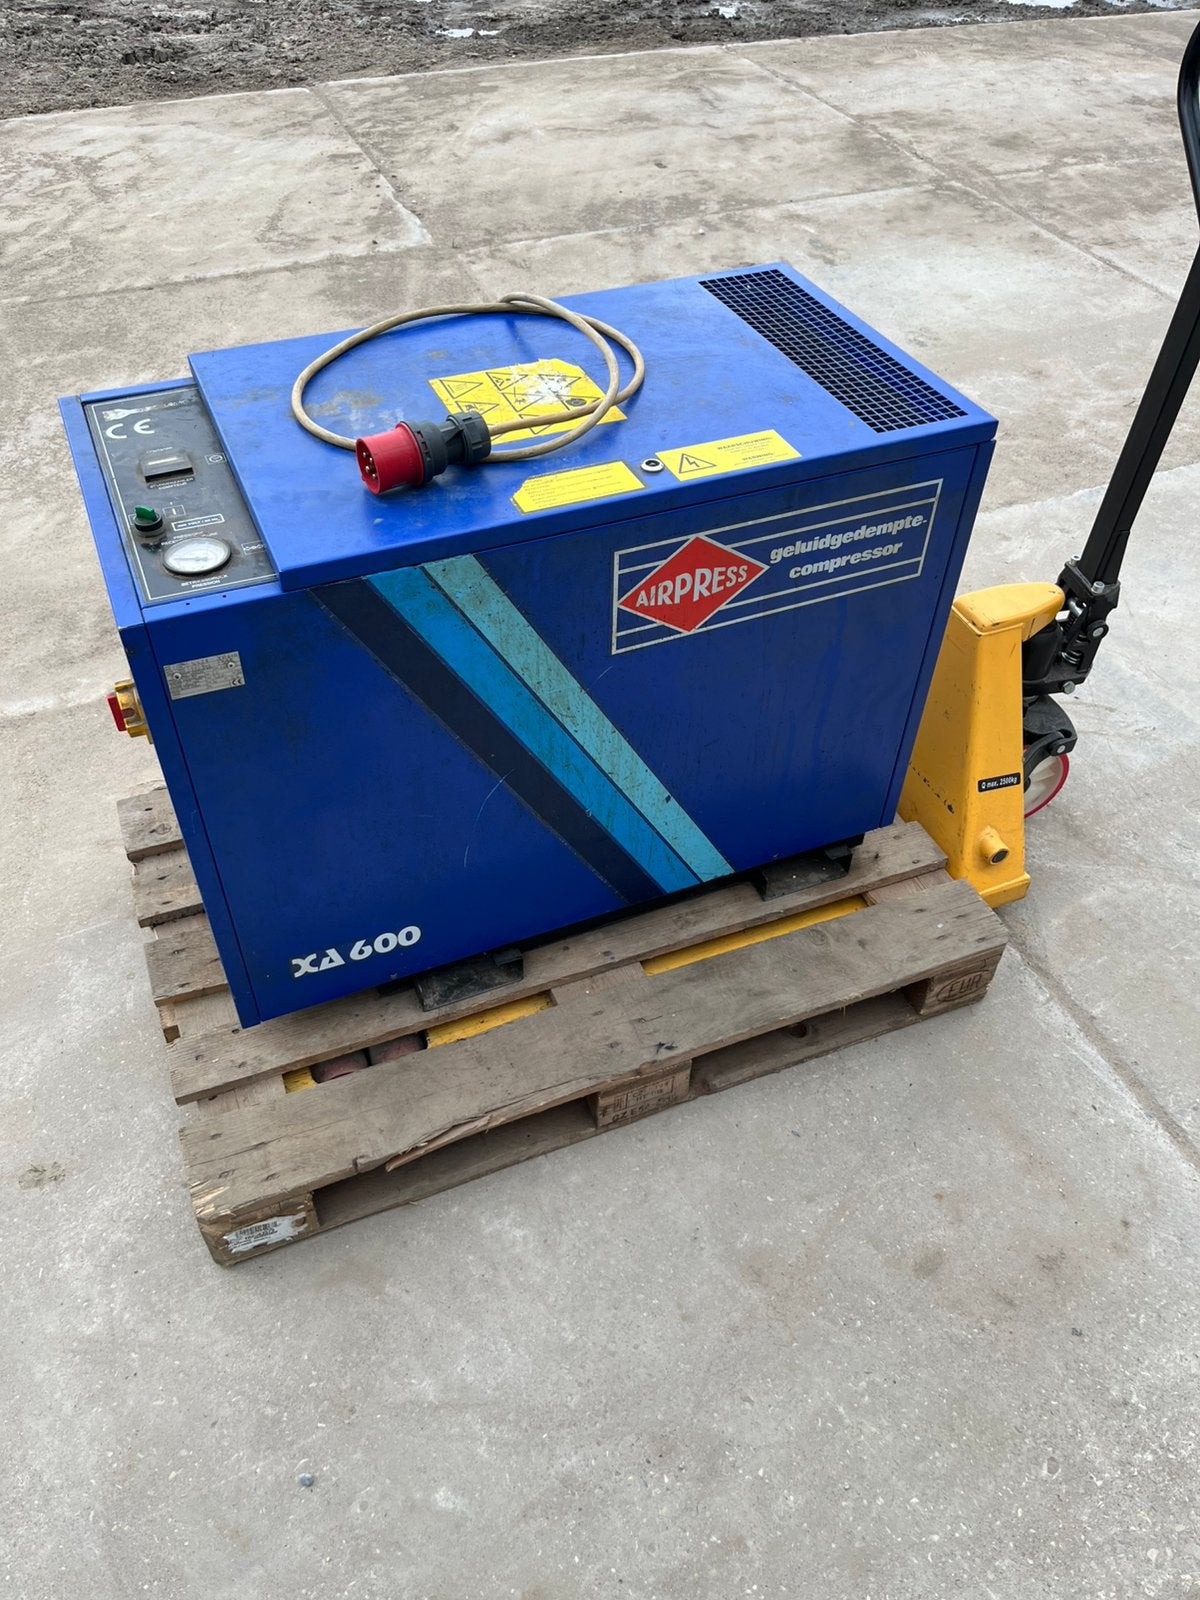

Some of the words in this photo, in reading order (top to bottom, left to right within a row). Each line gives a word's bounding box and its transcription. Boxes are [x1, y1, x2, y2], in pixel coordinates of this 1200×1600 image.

[769, 514, 927, 563] geluidgedempte-
[789, 541, 903, 579] compressor
[635, 564, 748, 608] AIRPRESS
[291, 947, 346, 978] XA
[349, 925, 422, 961] 600
